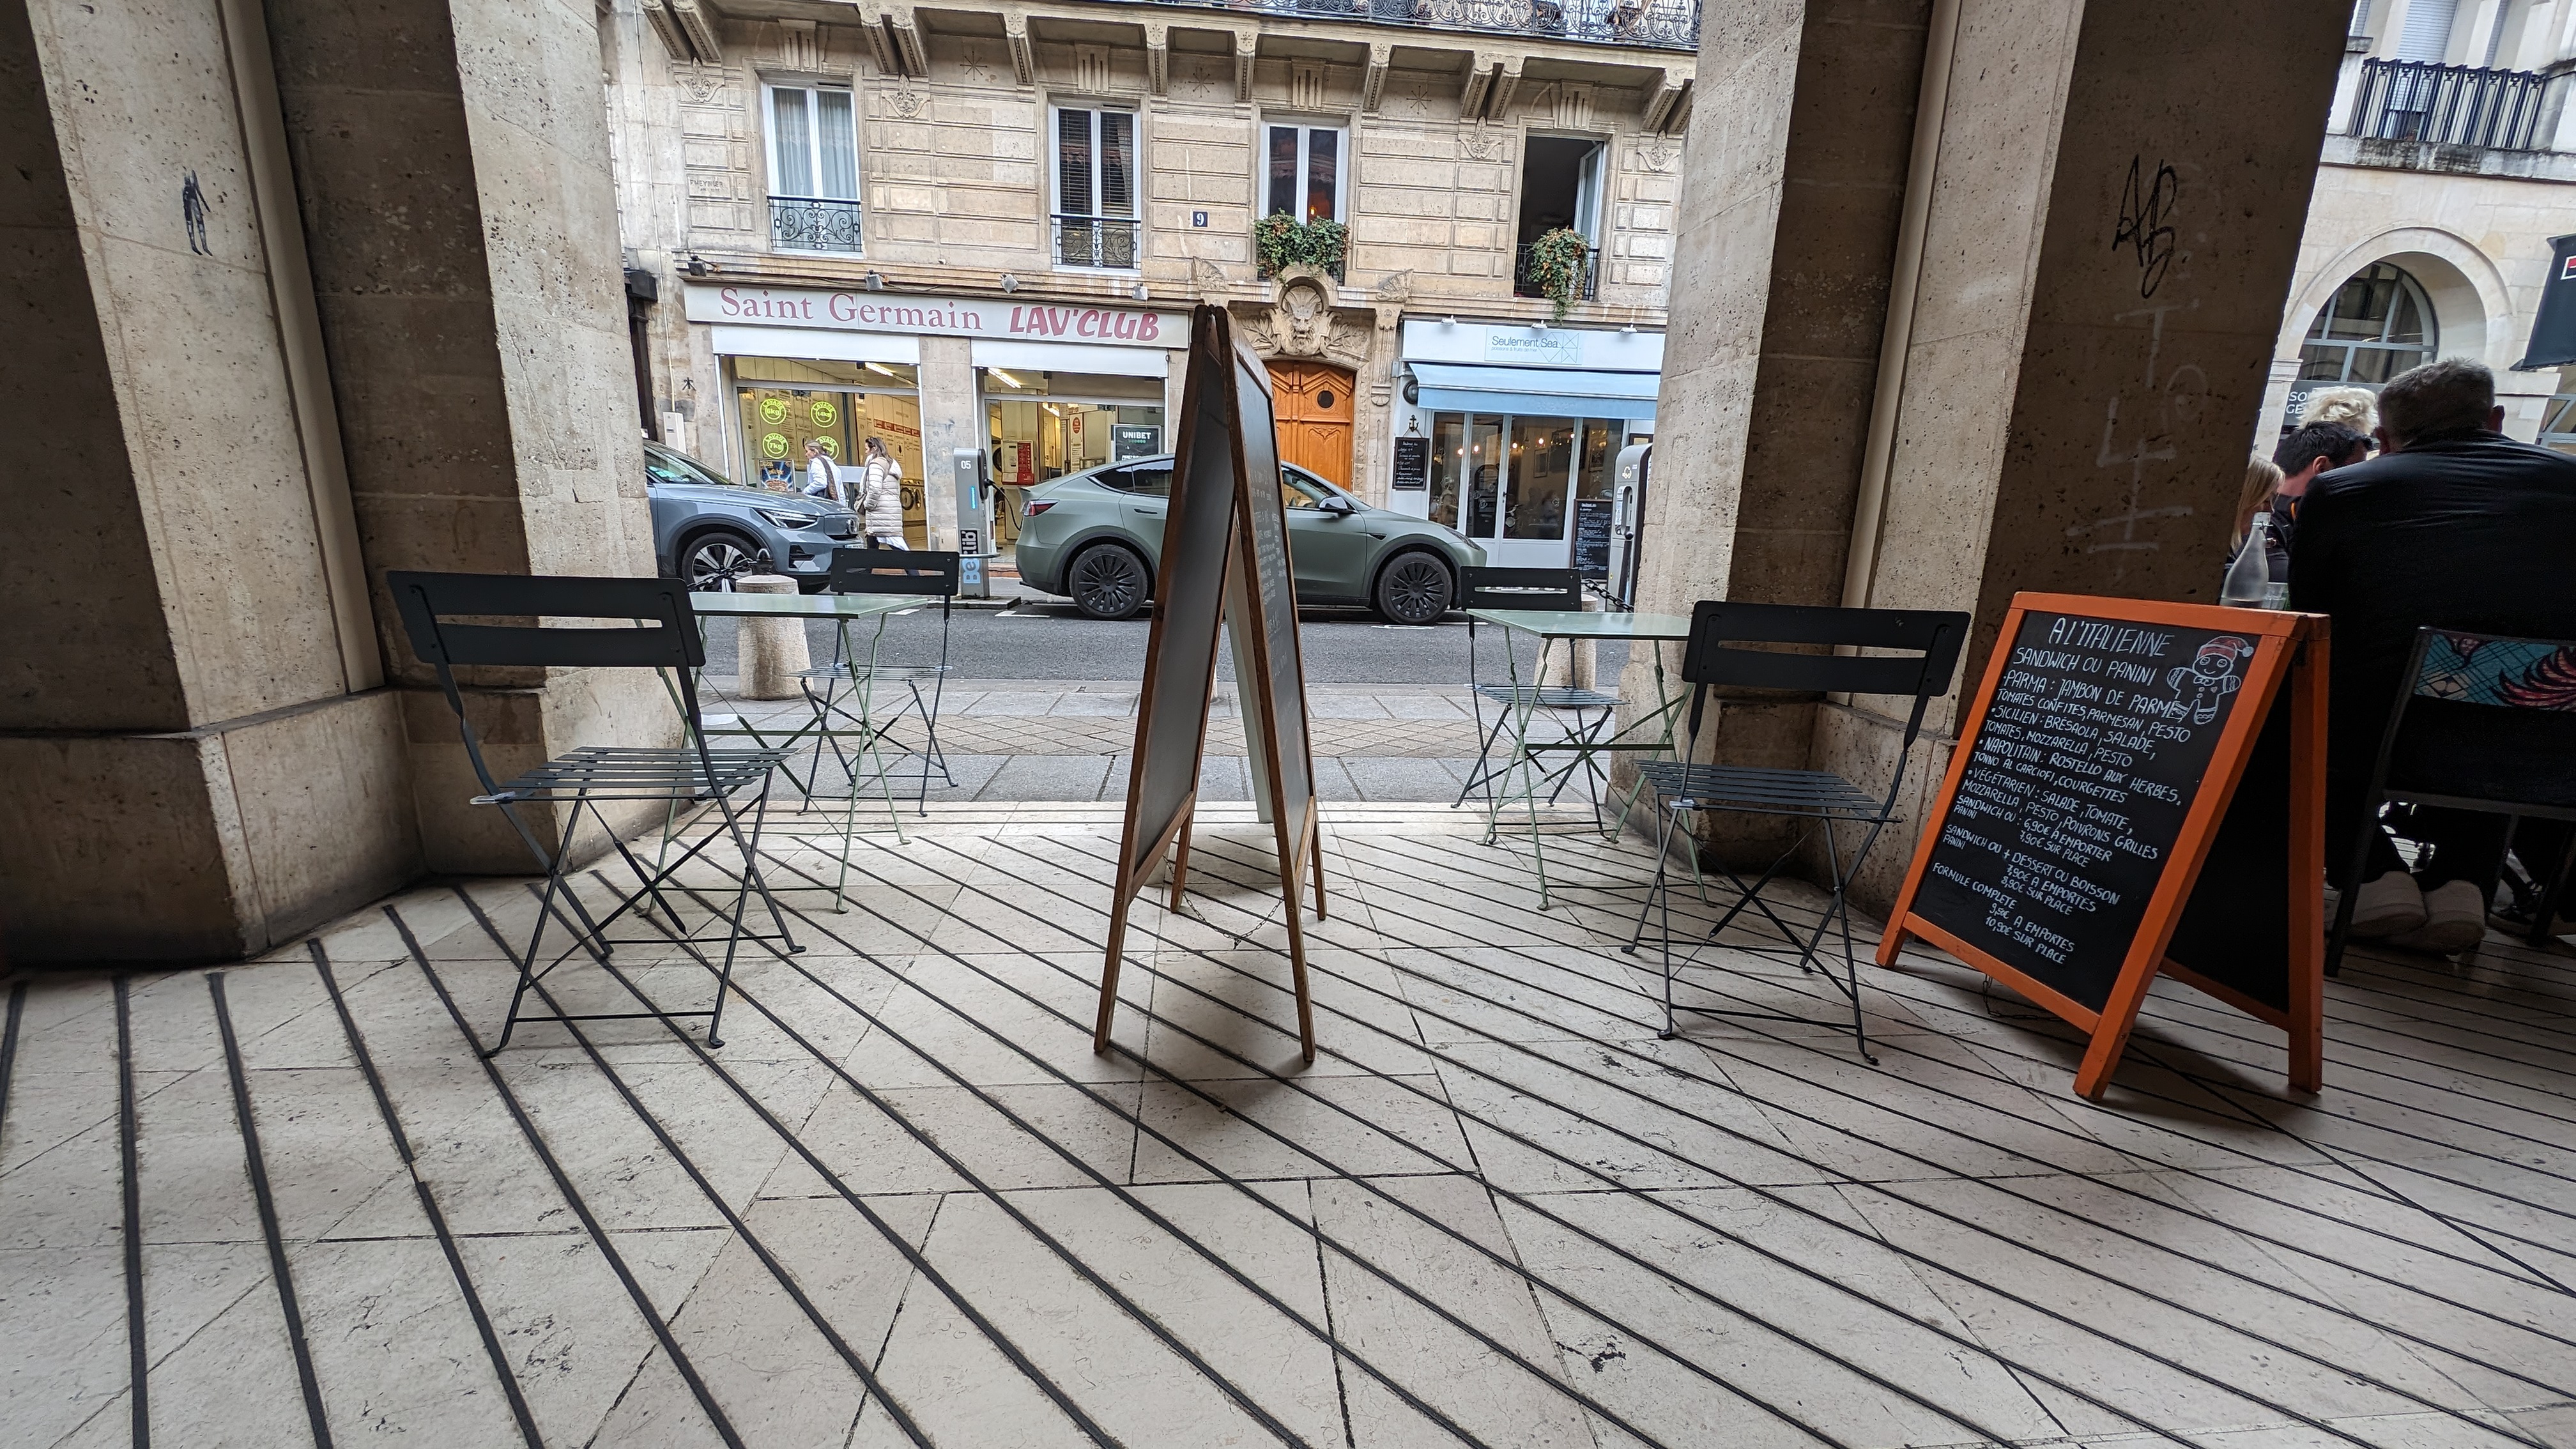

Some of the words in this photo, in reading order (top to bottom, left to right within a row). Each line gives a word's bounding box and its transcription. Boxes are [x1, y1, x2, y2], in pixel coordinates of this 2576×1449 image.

[1197, 213, 1204, 226] 9
[720, 286, 813, 320] Saint
[829, 293, 983, 331] Germain
[1009, 305, 1160, 341] LAV'CLUB
[1492, 335, 1538, 347] Seulement
[1540, 337, 1558, 348] Sea
[763, 399, 785, 410] LAVAGE
[764, 434, 786, 444] LAVAGE
[1123, 431, 1151, 440] UNIBET
[961, 460, 972, 470] 05
[2048, 617, 2066, 644] A
[2013, 647, 2081, 671] SANDWICH
[2082, 657, 2103, 673] OU
[2106, 661, 2157, 686] PANINI
[2053, 678, 2103, 702] JAMBON
[2105, 689, 2125, 706] DE
[2128, 694, 2178, 719] PARME
[1997, 688, 2035, 706] TOMATES
[2147, 721, 2191, 742] PESTO
[2049, 752, 2102, 776] ROSTELLO
[2103, 769, 2128, 783] AUX
[2094, 747, 2133, 767] PESTO
[1974, 751, 1999, 766] TONNO
[2003, 758, 2013, 770] AL
[2058, 775, 2128, 803] COURGETTES
[1954, 804, 1977, 820] PANINI
[1942, 834, 1966, 850] PANINI
[1956, 795, 2004, 819] SANDWICH
[2023, 818, 2051, 835] 6,90€
[2050, 831, 2060, 840] A
[2059, 834, 2113, 861] EMPORTER
[2062, 816, 2111, 843] POIVRONS
[2115, 836, 2158, 859] GRILLES
[1946, 824, 1988, 848] SANDWICH
[1988, 842, 2002, 853] OU
[2012, 852, 2056, 877] DESSERT
[2055, 870, 2070, 882] OU
[2070, 877, 2120, 905] BOISSON
[2020, 830, 2045, 847] 7,90€
[2044, 841, 2062, 855] SUR
[2062, 848, 2090, 868] PLACE
[1932, 862, 1971, 886] FORMULE
[1972, 881, 2017, 909] COMPLETE
[2007, 864, 2031, 882] 7,90€
[2031, 877, 2039, 887] A
[2000, 876, 2025, 893] 8,90€
[2026, 887, 2043, 901] SUR
[2044, 895, 2073, 916] PLACE
[2013, 916, 2023, 928] A
[2013, 930, 2034, 947] SUR
[2035, 943, 2067, 964] PLACE
